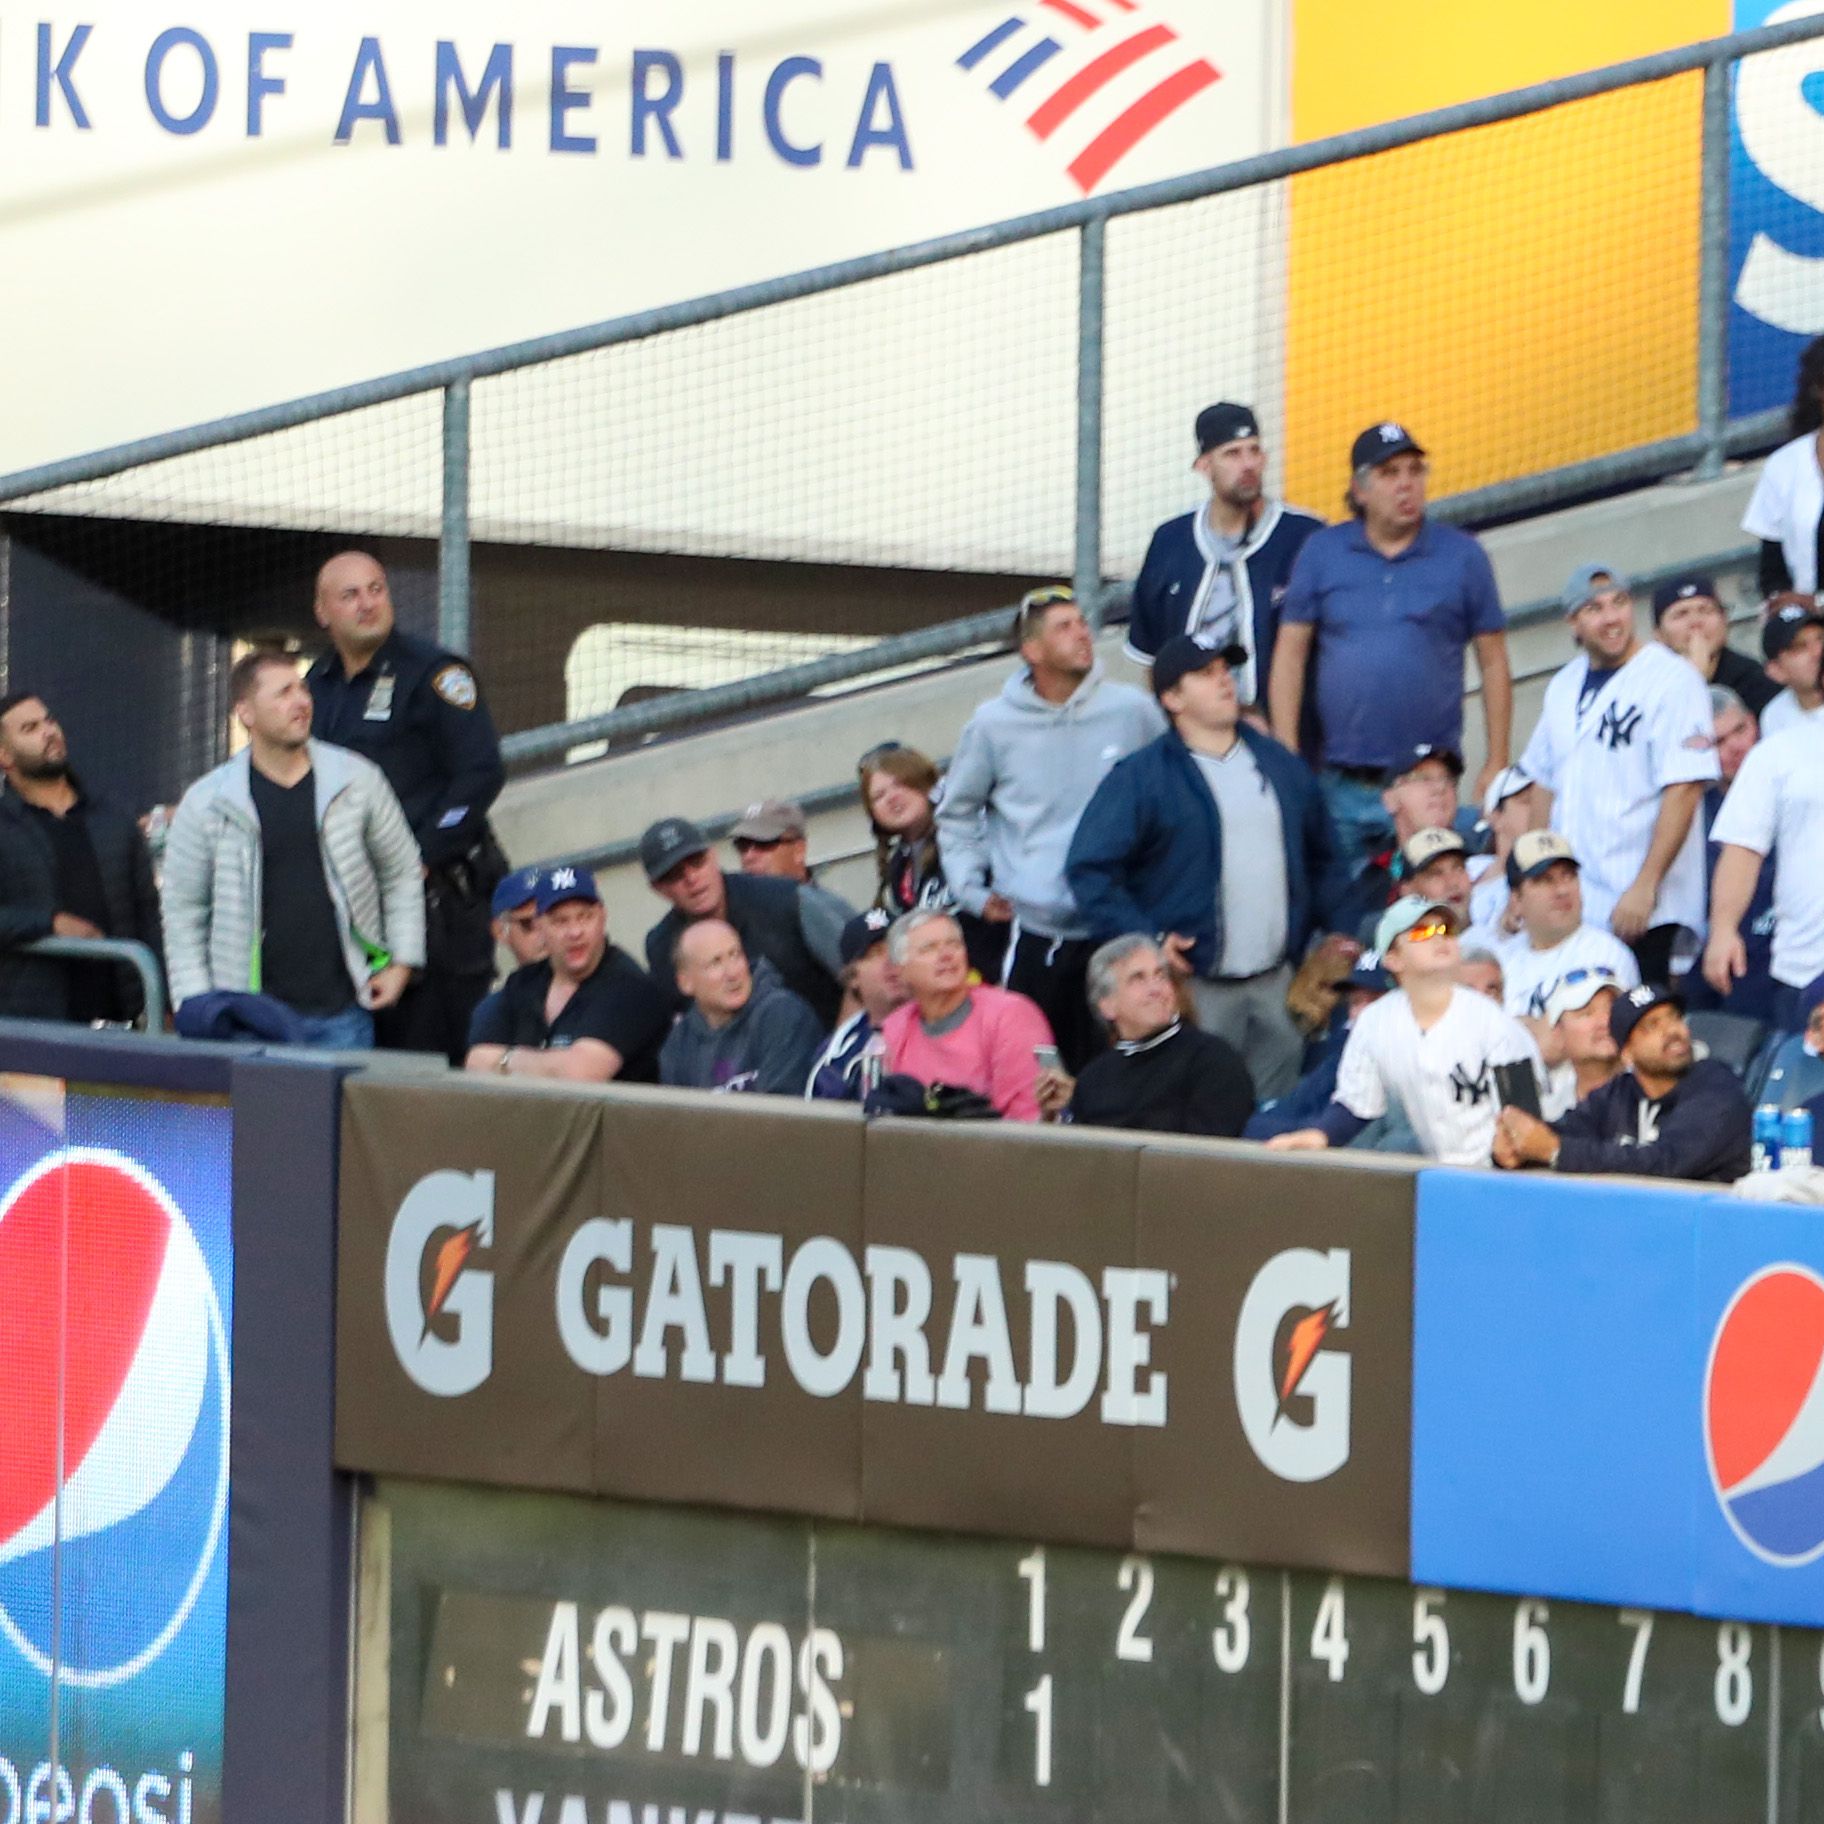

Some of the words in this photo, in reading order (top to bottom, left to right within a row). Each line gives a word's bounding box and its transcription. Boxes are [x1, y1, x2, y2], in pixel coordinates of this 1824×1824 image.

[142, 25, 296, 138] OF
[332, 36, 920, 173] AMERICA
[384, 1168, 495, 1398] G
[555, 1217, 1168, 1428] GATORADE
[1234, 1246, 1351, 1484] G
[527, 1601, 844, 1772] ASTROS
[1025, 1674, 1051, 1786] 1
[1020, 1547, 1046, 1651] 1
[1117, 1558, 1153, 1662] 2
[1213, 1567, 1250, 1673] 3
[1310, 1575, 1349, 1681] 4
[1411, 1590, 1449, 1694] 5
[1513, 1600, 1550, 1704] 6
[1620, 1609, 1655, 1713] 7
[1714, 1622, 1752, 1726] 8
